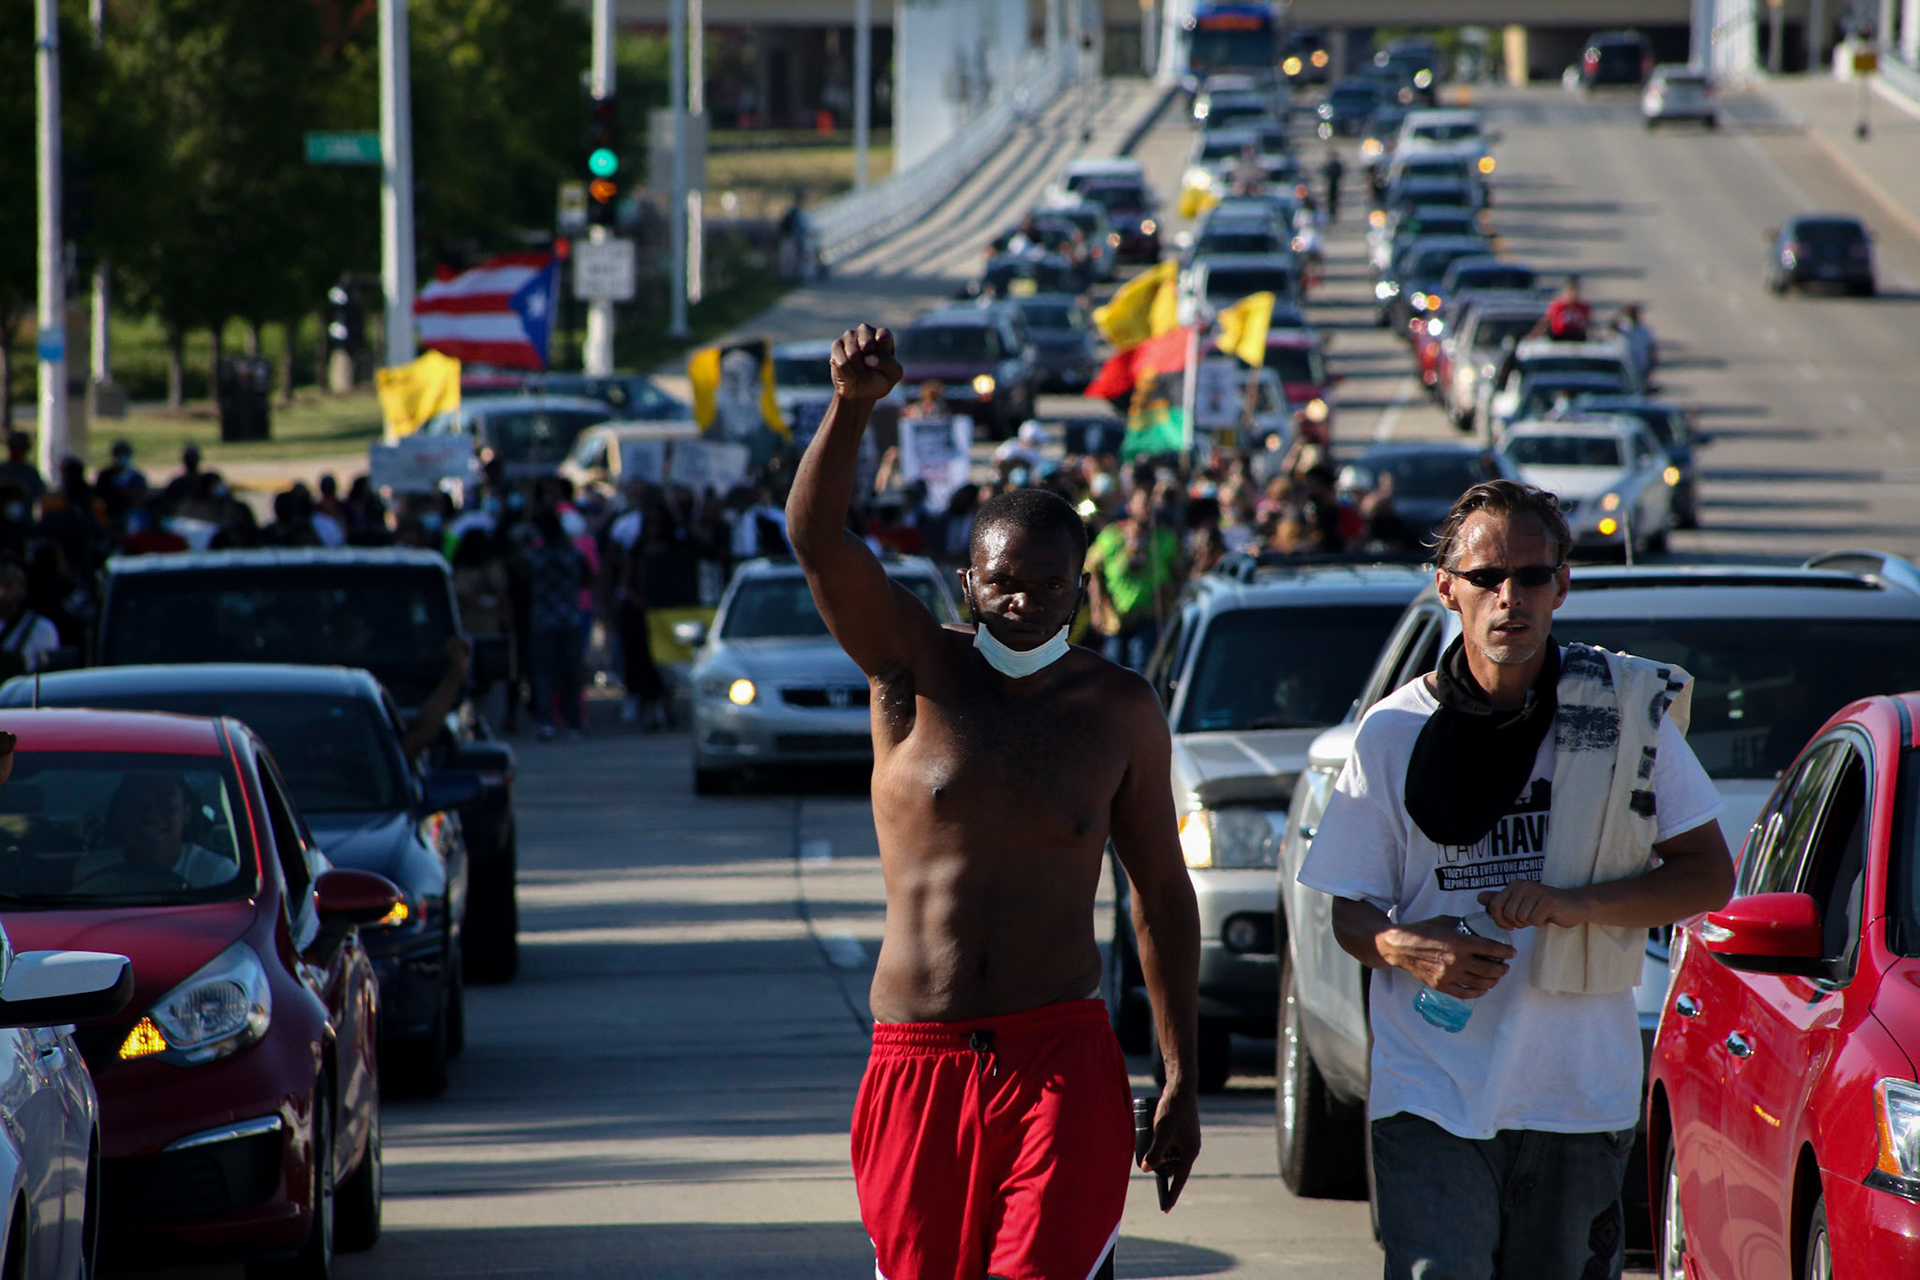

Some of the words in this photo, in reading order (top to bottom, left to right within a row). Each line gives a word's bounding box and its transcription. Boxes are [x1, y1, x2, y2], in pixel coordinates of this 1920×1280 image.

[1491, 814, 1549, 856] HAV
[1480, 862, 1517, 875] EVERYONE
[1470, 874, 1504, 887] ANOTHER
